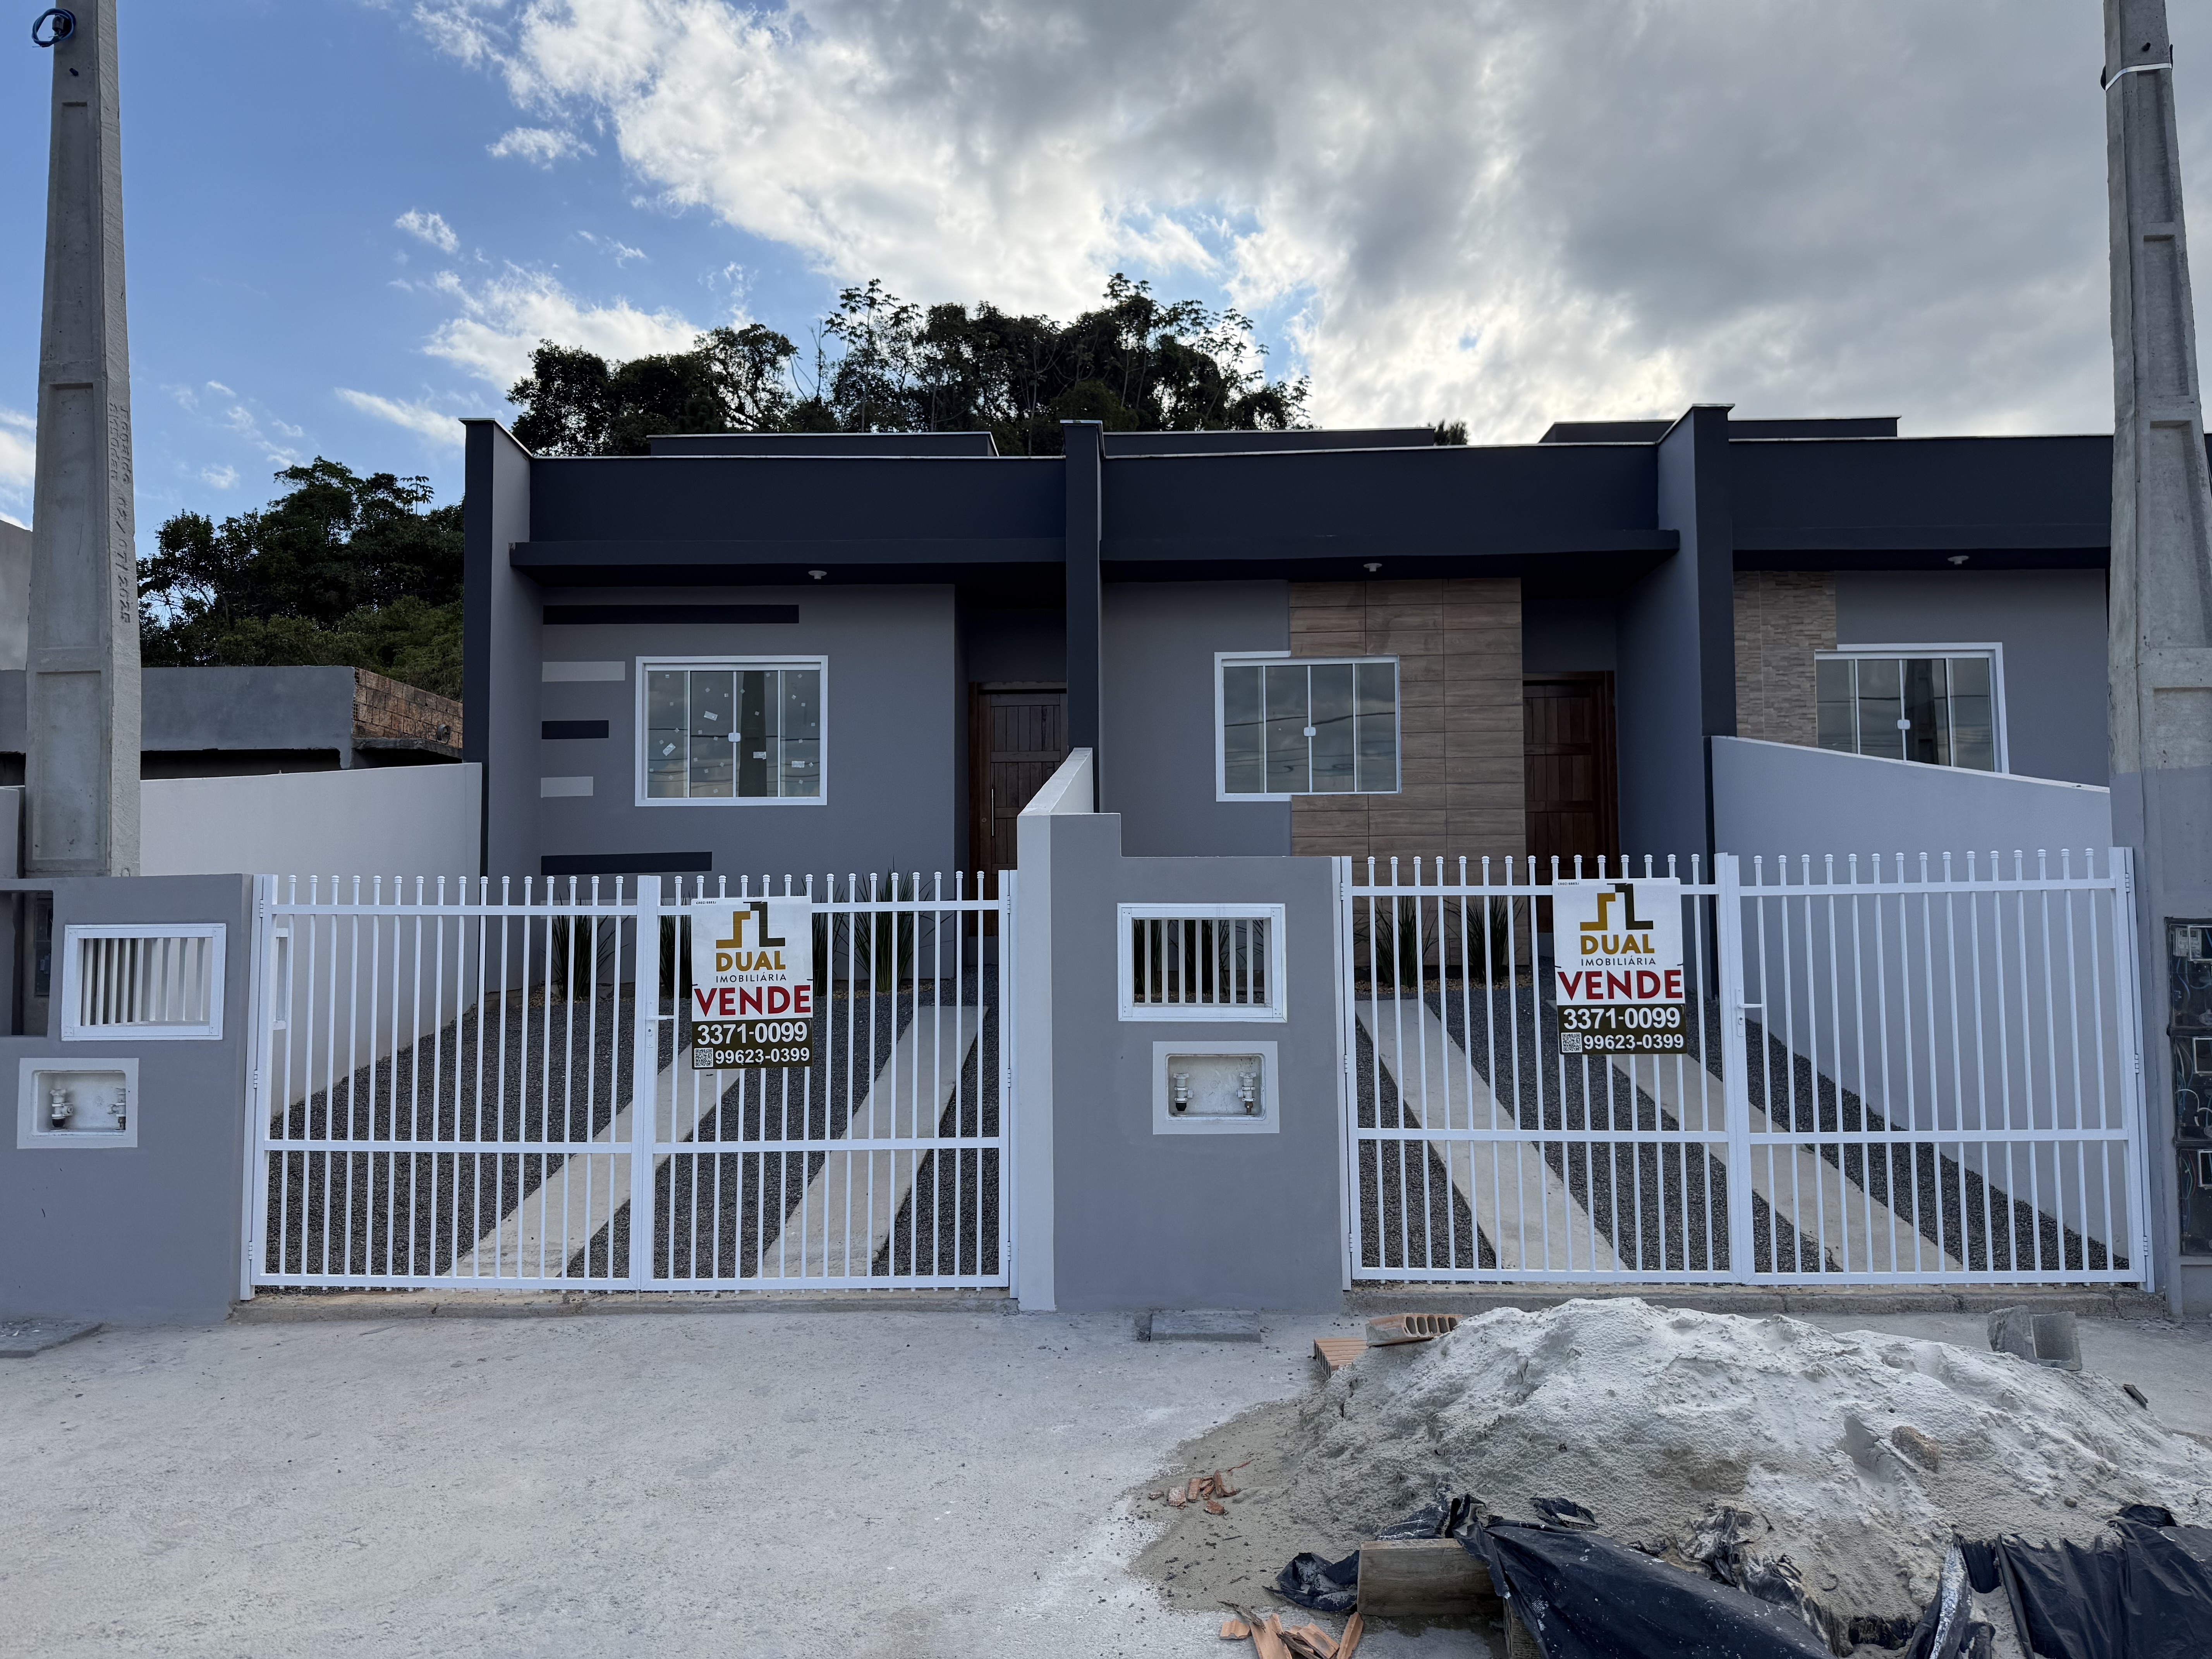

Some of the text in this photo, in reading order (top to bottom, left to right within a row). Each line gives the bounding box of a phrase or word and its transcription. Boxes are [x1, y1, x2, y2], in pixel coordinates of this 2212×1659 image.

[1580, 934, 1655, 955] DUAL
[716, 951, 786, 972] DUAL
[1581, 956, 1656, 966] IMOBILIÁRIA
[716, 972, 787, 983] IMOBILIÁRIA
[1558, 970, 1683, 1001] VENDE
[694, 985, 811, 1017] VENDE
[1563, 1007, 1680, 1029] 3371-0099
[697, 1021, 807, 1045] 3371-0099
[1583, 1034, 1684, 1049] 99623-0399
[715, 1048, 810, 1064] 99623-0399
